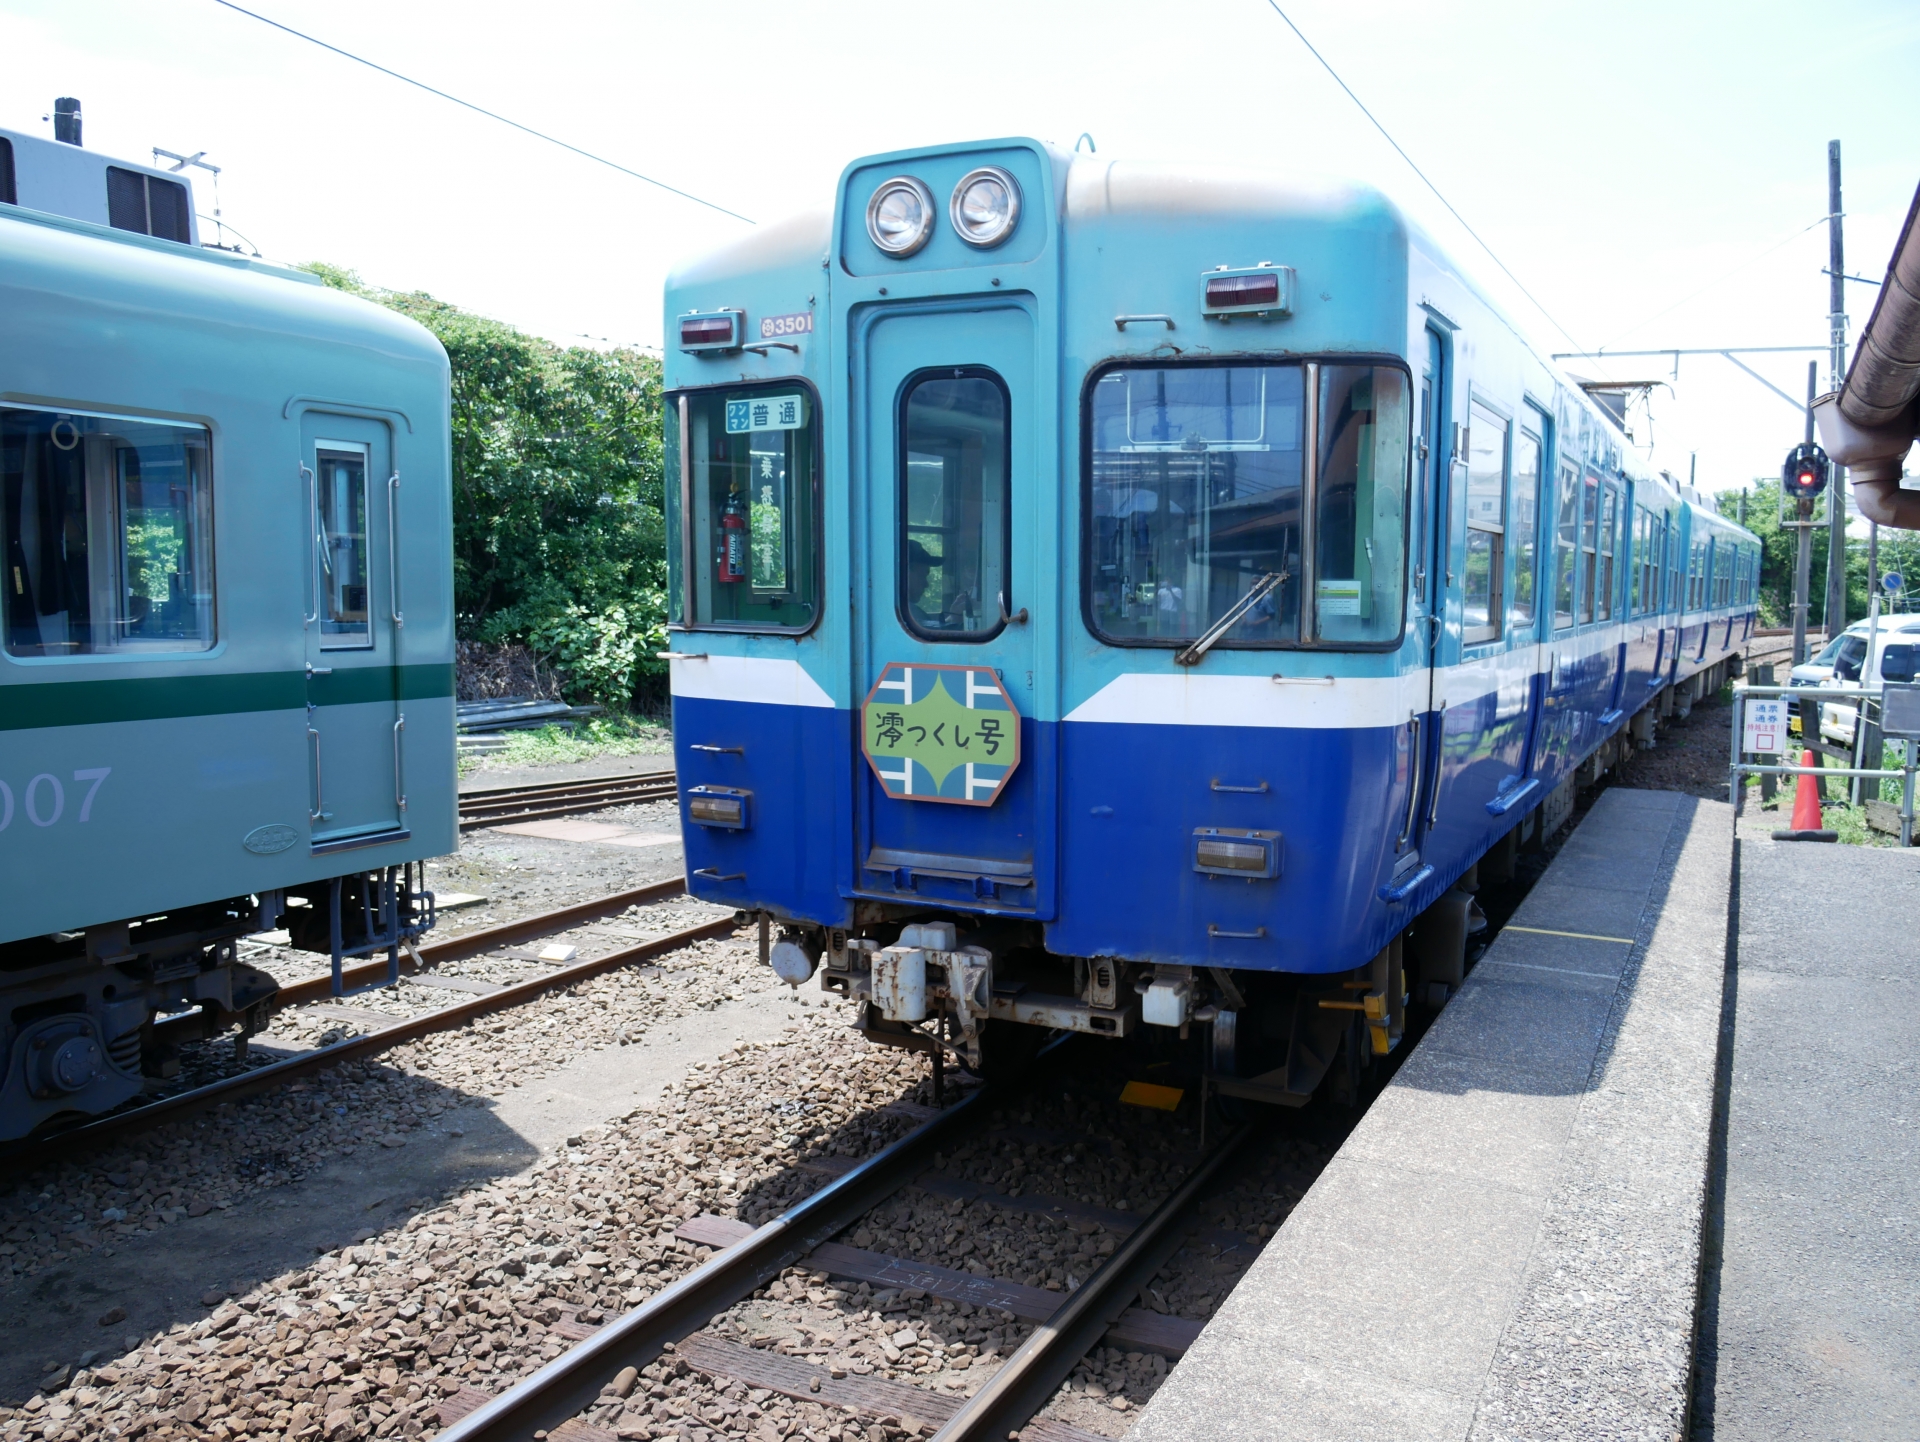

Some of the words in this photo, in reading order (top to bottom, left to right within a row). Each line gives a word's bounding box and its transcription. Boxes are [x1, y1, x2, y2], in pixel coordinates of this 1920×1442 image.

[775, 315, 812, 334] 3501
[729, 404, 747, 417] ワン
[752, 401, 796, 427] 普通
[730, 418, 749, 430] マン
[876, 711, 1005, 756] 澪つくし号
